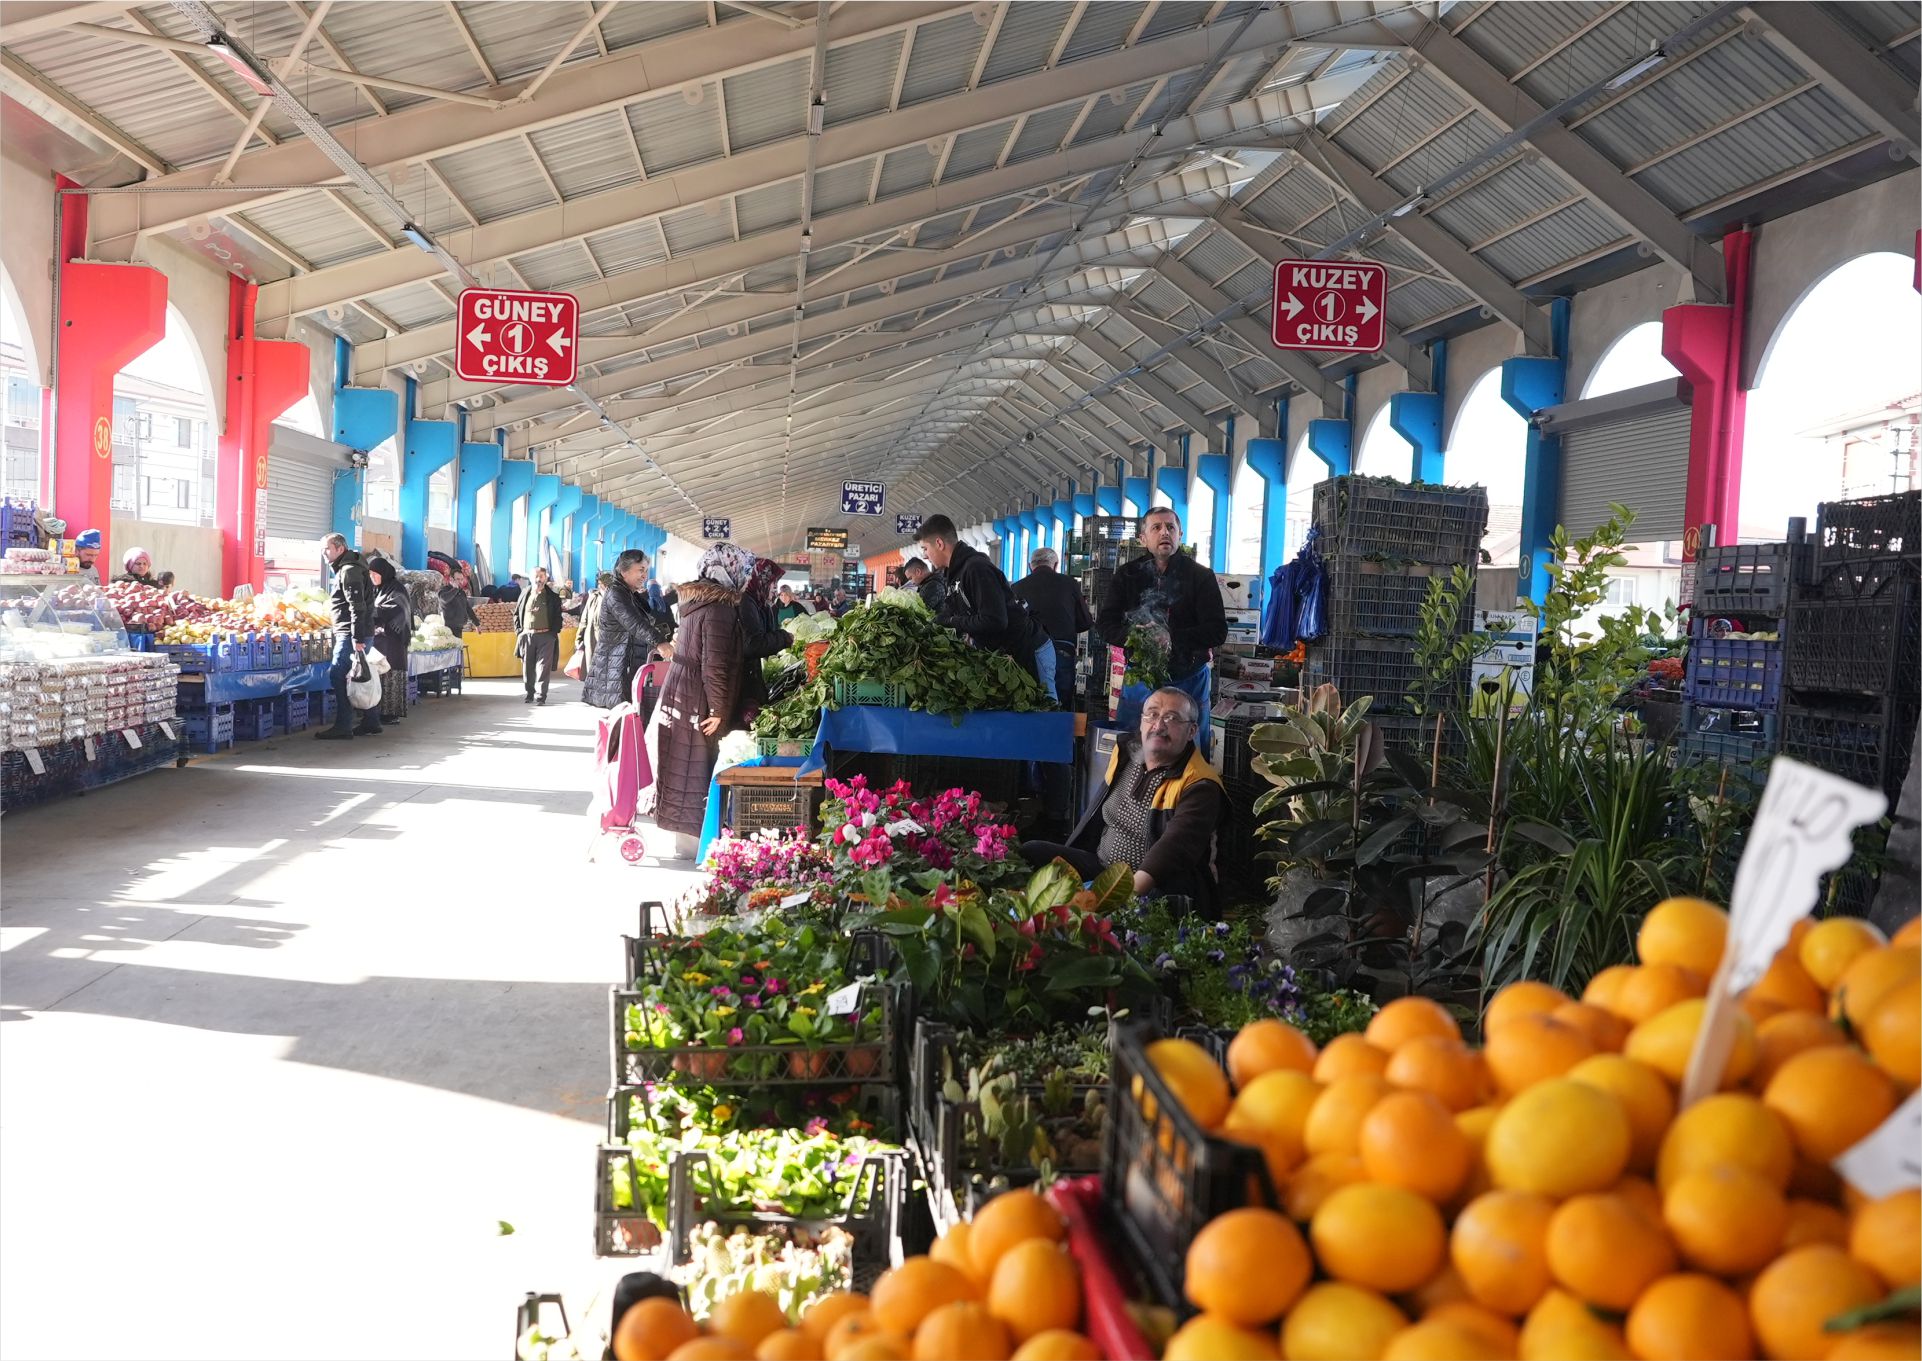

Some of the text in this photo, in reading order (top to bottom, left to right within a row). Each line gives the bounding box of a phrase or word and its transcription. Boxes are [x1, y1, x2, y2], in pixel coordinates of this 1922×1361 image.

[1292, 267, 1374, 290] KUZEY
[474, 296, 565, 323] GÜNEY
[1321, 293, 1335, 321] 1
[508, 324, 523, 353] 1
[1296, 323, 1359, 346] ÇIKIŞ
[482, 355, 549, 379] ÇIKIŞ
[844, 481, 882, 493] ÜRETİCİ
[848, 492, 879, 502] PAZARI
[858, 501, 866, 512] 2
[1686, 532, 1698, 551] 14
